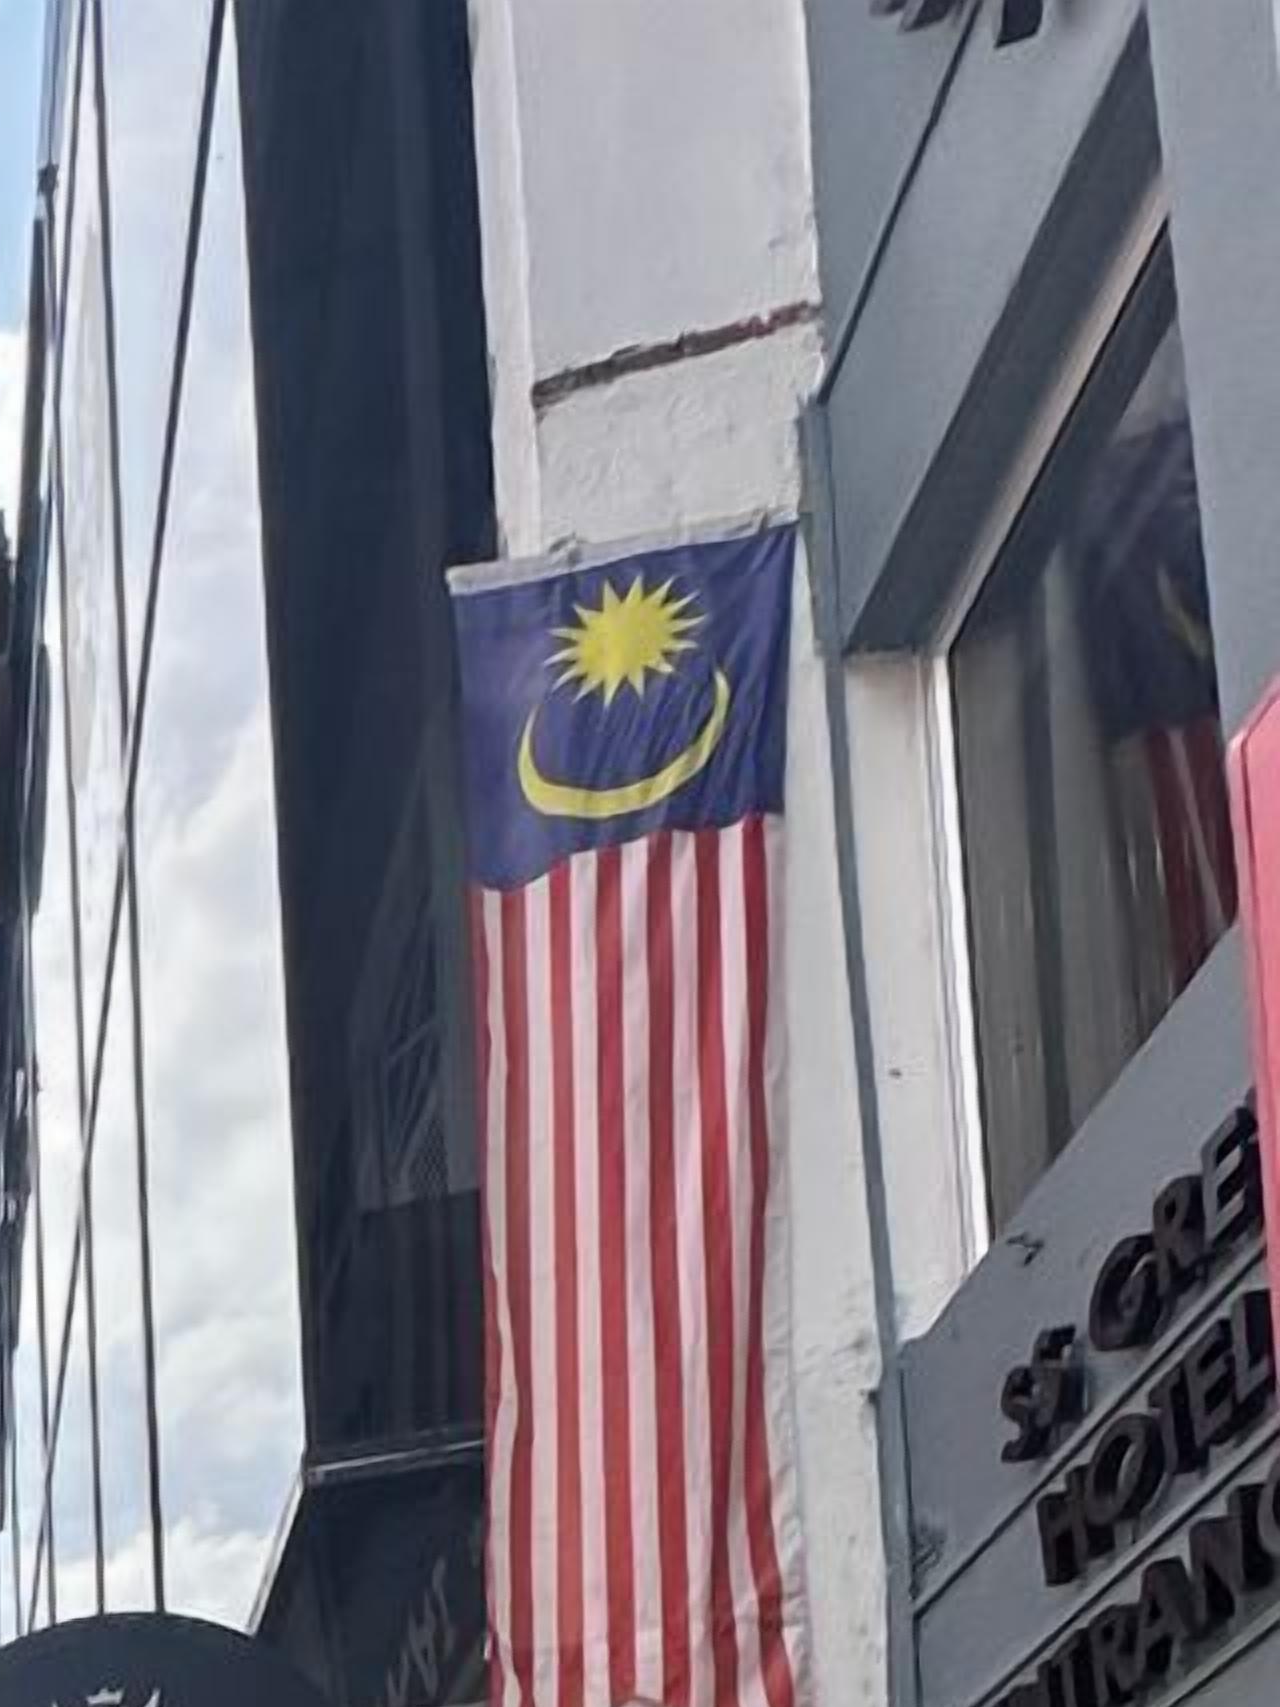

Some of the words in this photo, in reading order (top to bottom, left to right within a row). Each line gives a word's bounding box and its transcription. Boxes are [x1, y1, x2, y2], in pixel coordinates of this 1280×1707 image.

[1001, 1325, 1084, 1463] SS
[1088, 1085, 1266, 1352] GRE
[1036, 1288, 1278, 1587] HOTEL
